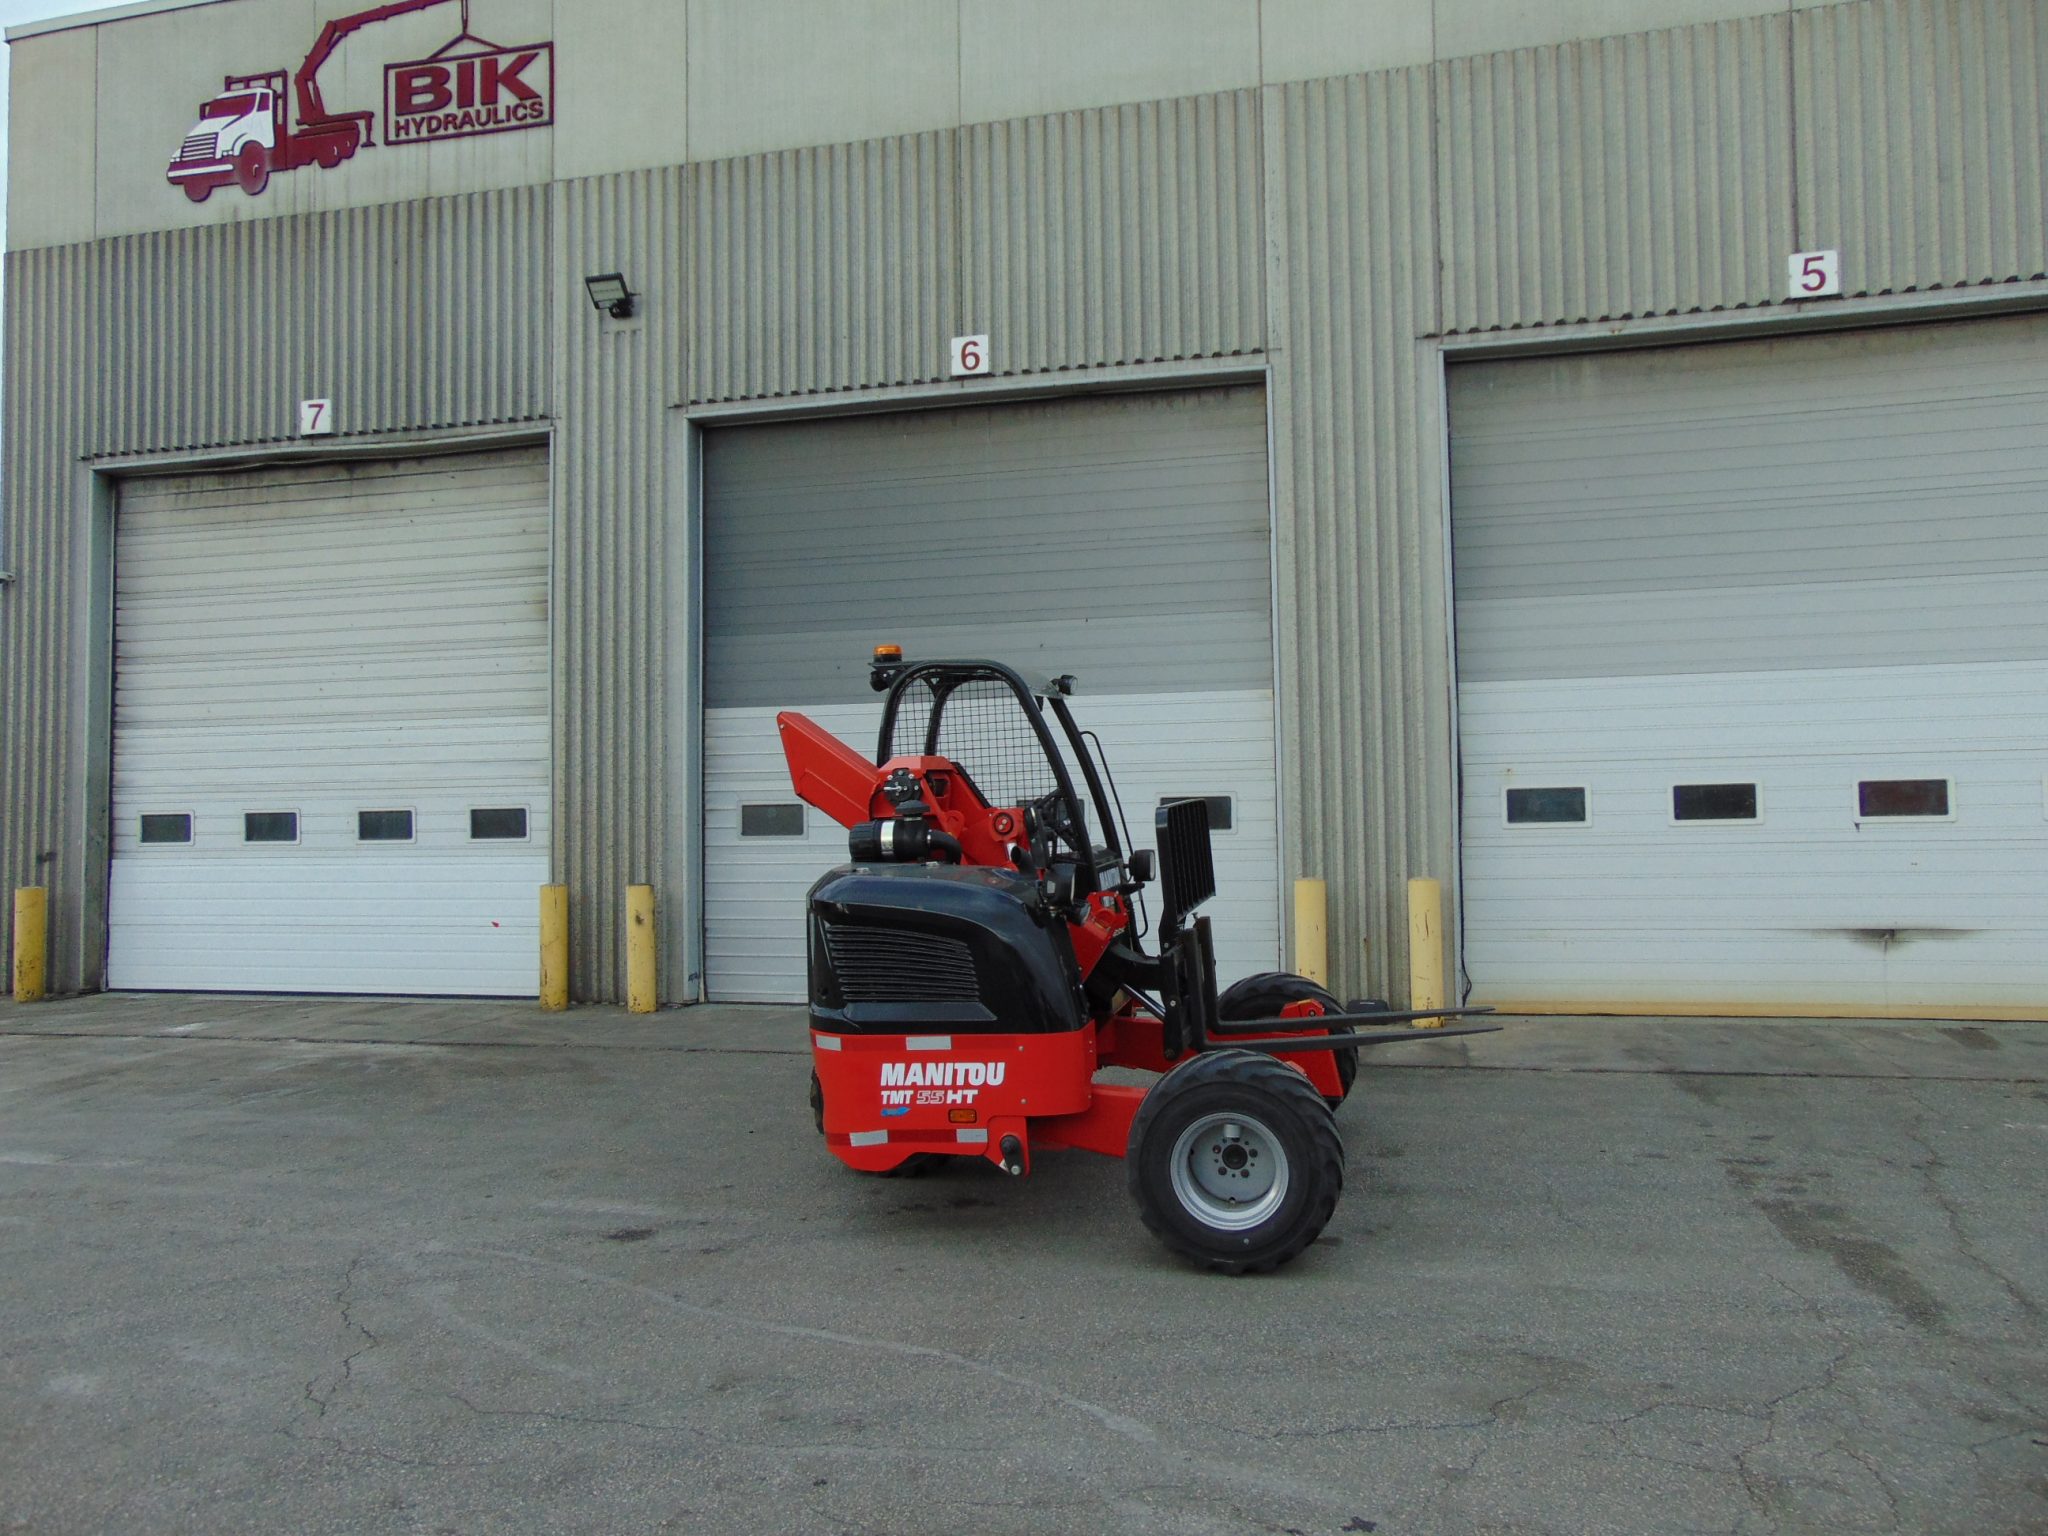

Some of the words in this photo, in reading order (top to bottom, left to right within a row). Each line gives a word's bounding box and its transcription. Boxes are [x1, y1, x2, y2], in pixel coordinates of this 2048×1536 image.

[394, 52, 542, 117] BIK
[394, 101, 544, 138] HYDRAULICS
[1802, 255, 1826, 291] 5
[961, 341, 980, 371] 6
[308, 403, 325, 430] 7
[880, 1062, 1006, 1087] MANITOU
[880, 1089, 914, 1105] TMT
